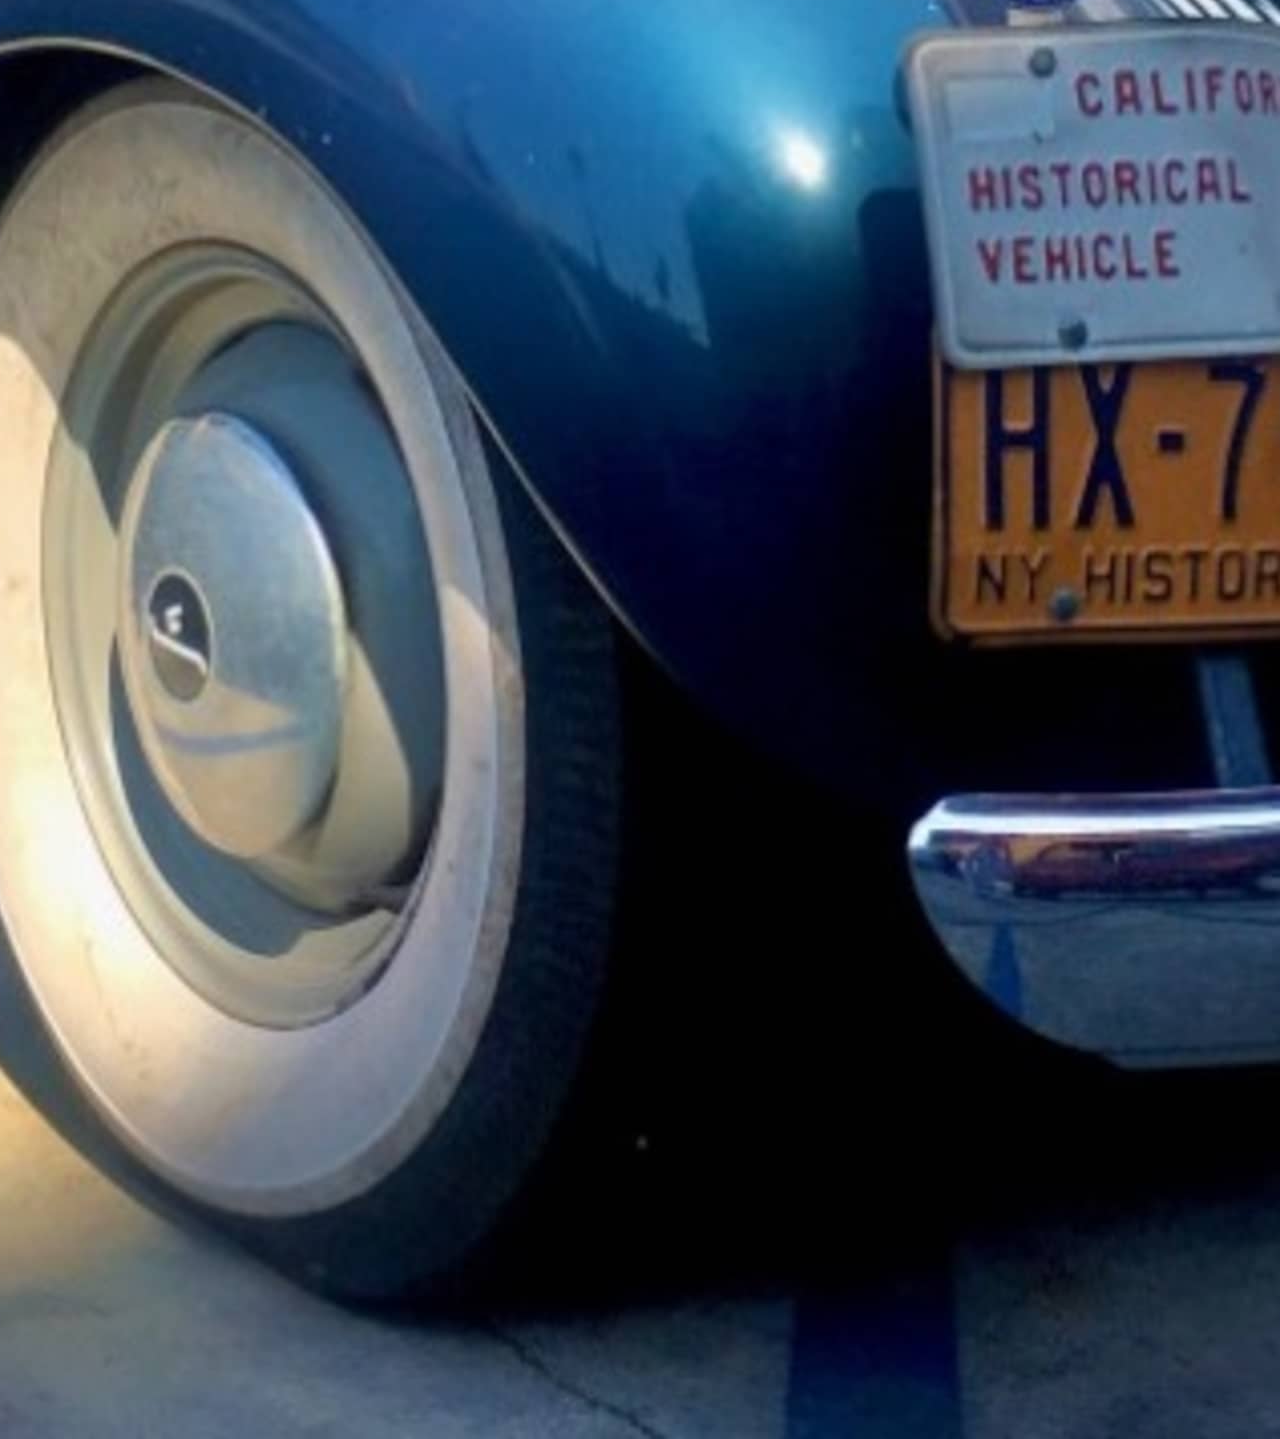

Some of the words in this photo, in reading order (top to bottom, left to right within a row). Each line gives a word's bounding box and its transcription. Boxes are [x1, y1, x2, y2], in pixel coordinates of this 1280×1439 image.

[968, 157, 1251, 212] HISTORICAL
[977, 230, 1180, 285] VEHICLE
[977, 554, 1050, 604] NY
